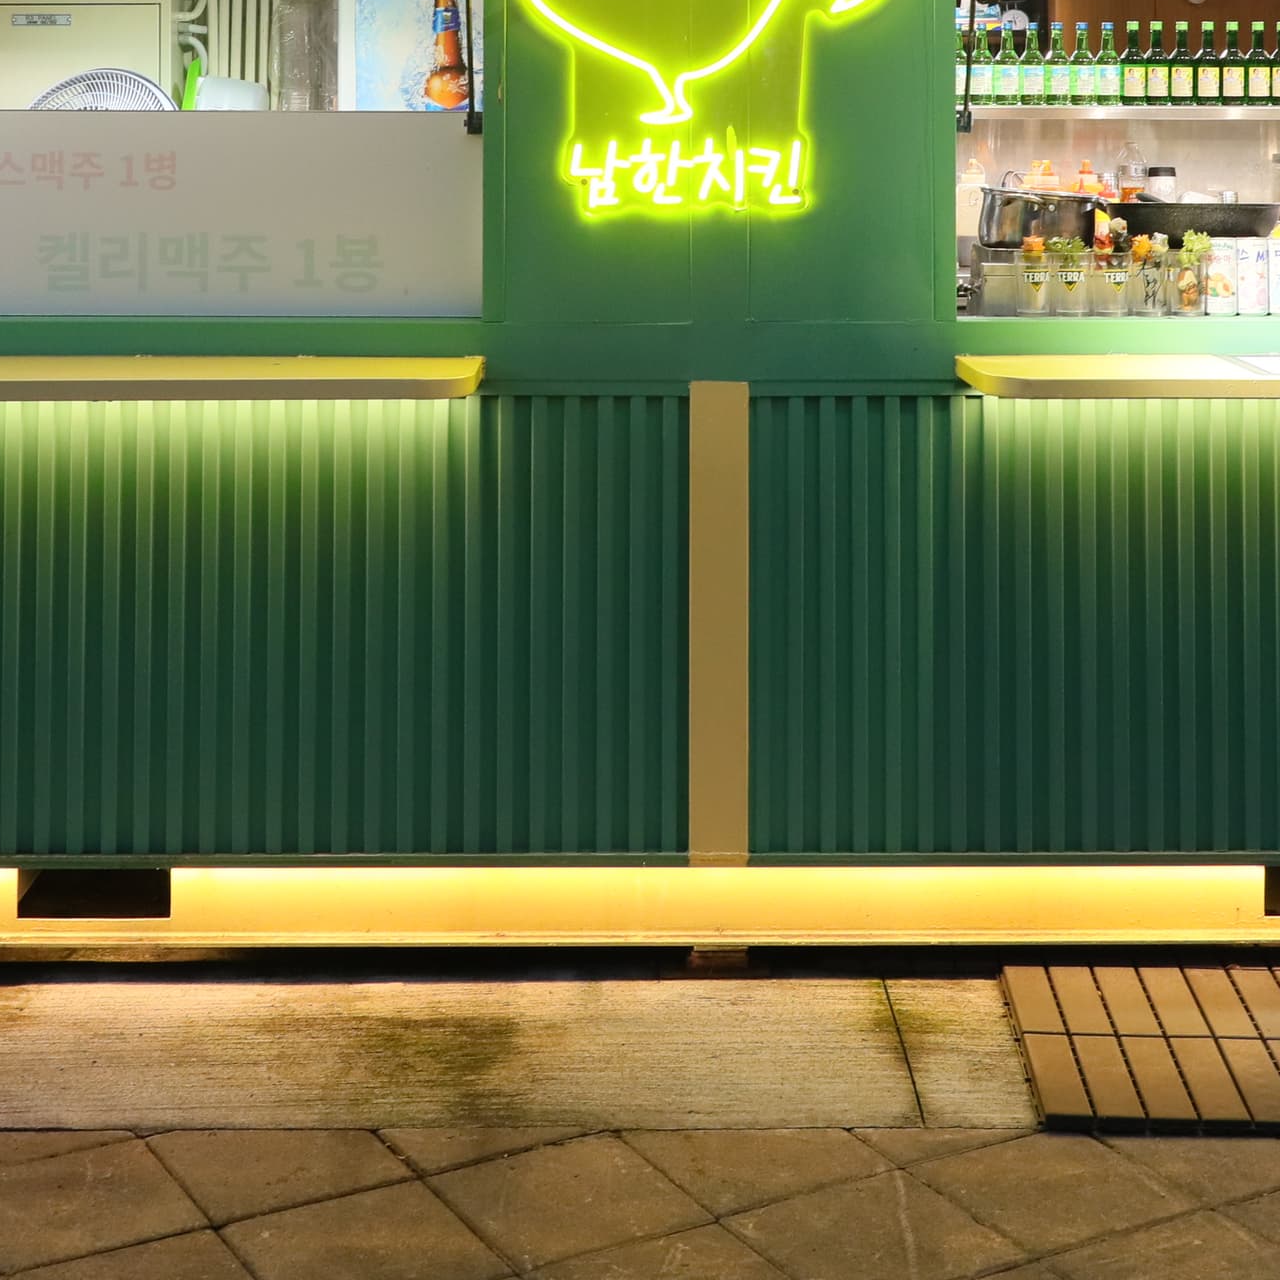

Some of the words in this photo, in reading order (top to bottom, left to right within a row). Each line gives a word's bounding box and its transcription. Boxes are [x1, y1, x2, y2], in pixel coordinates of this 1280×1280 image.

[120, 150, 179, 192] 1병
[569, 138, 802, 208] 남한치킨
[34, 230, 273, 293] 켈리맥주
[1023, 271, 1050, 284] TERRA
[1056, 271, 1086, 283] TERRA
